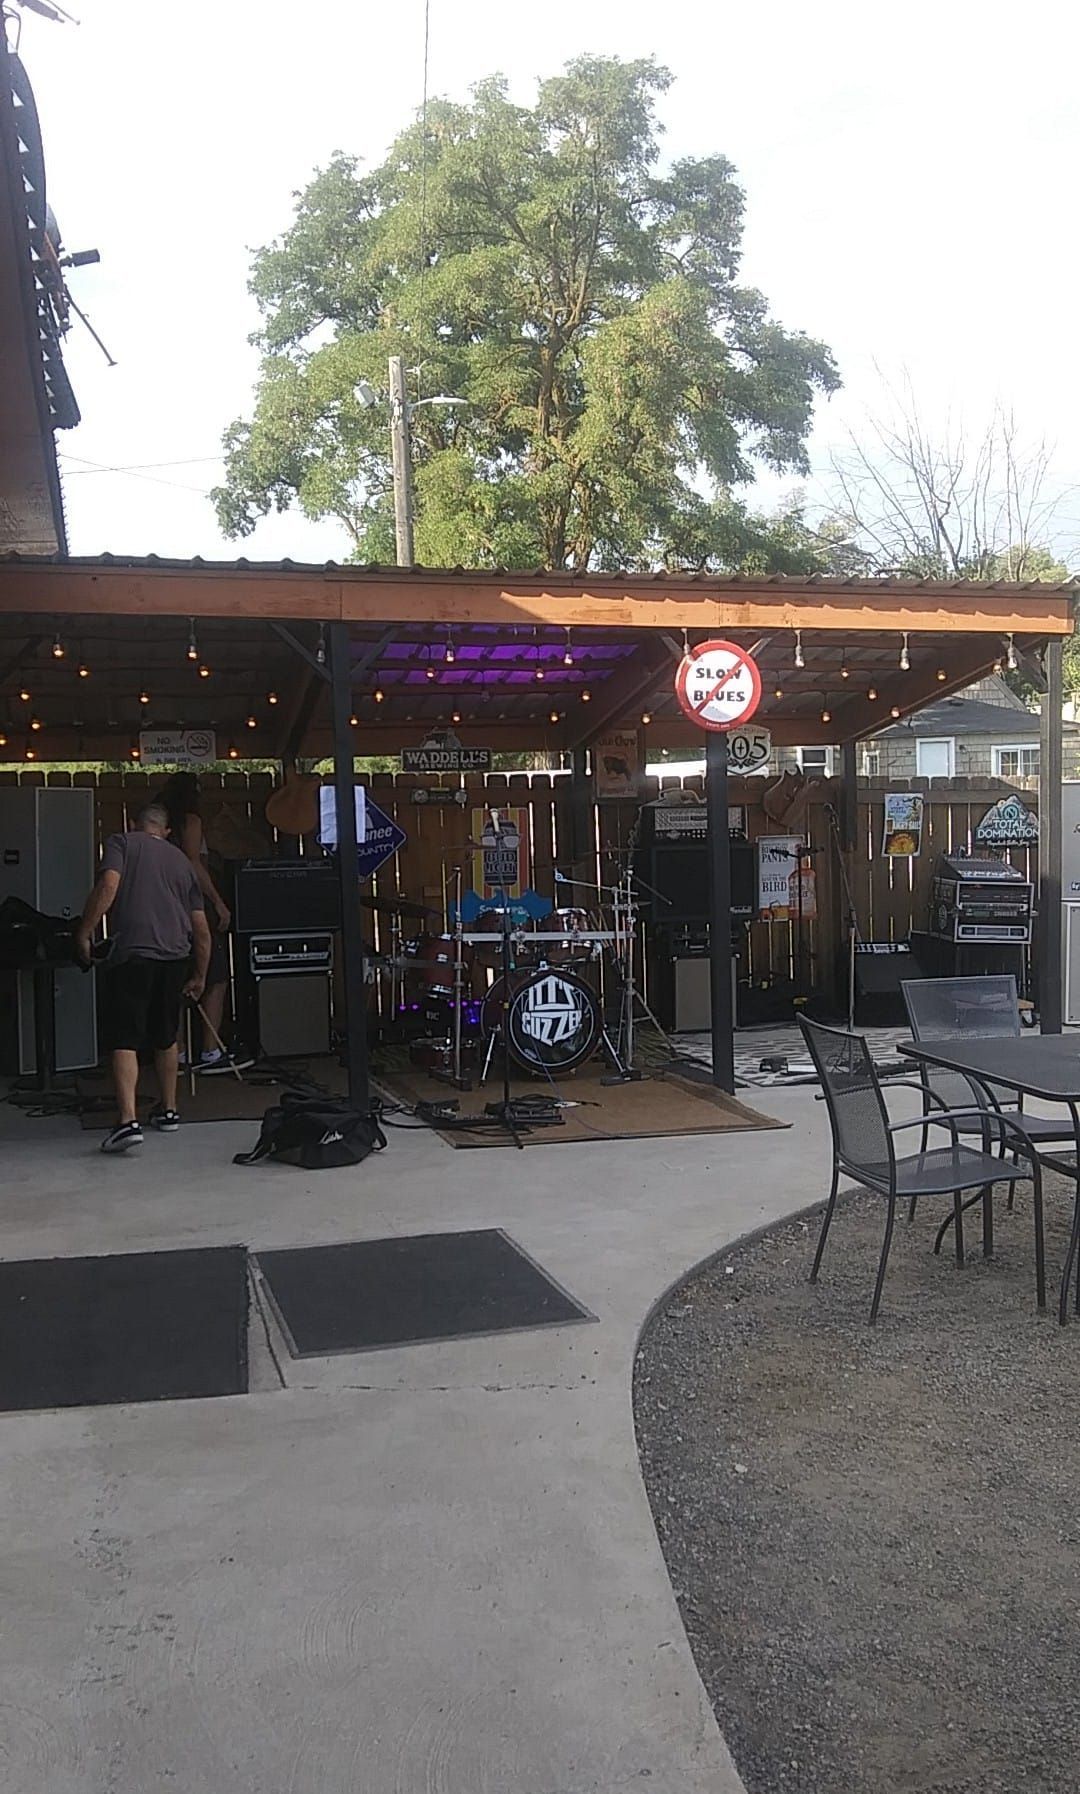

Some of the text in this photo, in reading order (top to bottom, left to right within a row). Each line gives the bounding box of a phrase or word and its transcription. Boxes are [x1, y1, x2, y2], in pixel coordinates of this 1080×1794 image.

[695, 668, 742, 680] SLOW
[693, 690, 746, 702] BLUES
[157, 736, 171, 745] NO
[143, 746, 186, 754] SMOKING
[726, 736, 768, 760] 05
[405, 751, 489, 764] WADDELL'S
[993, 820, 1026, 829] TOTAL
[977, 829, 1039, 839] DOMINATION
[762, 881, 788, 893] BIRD
